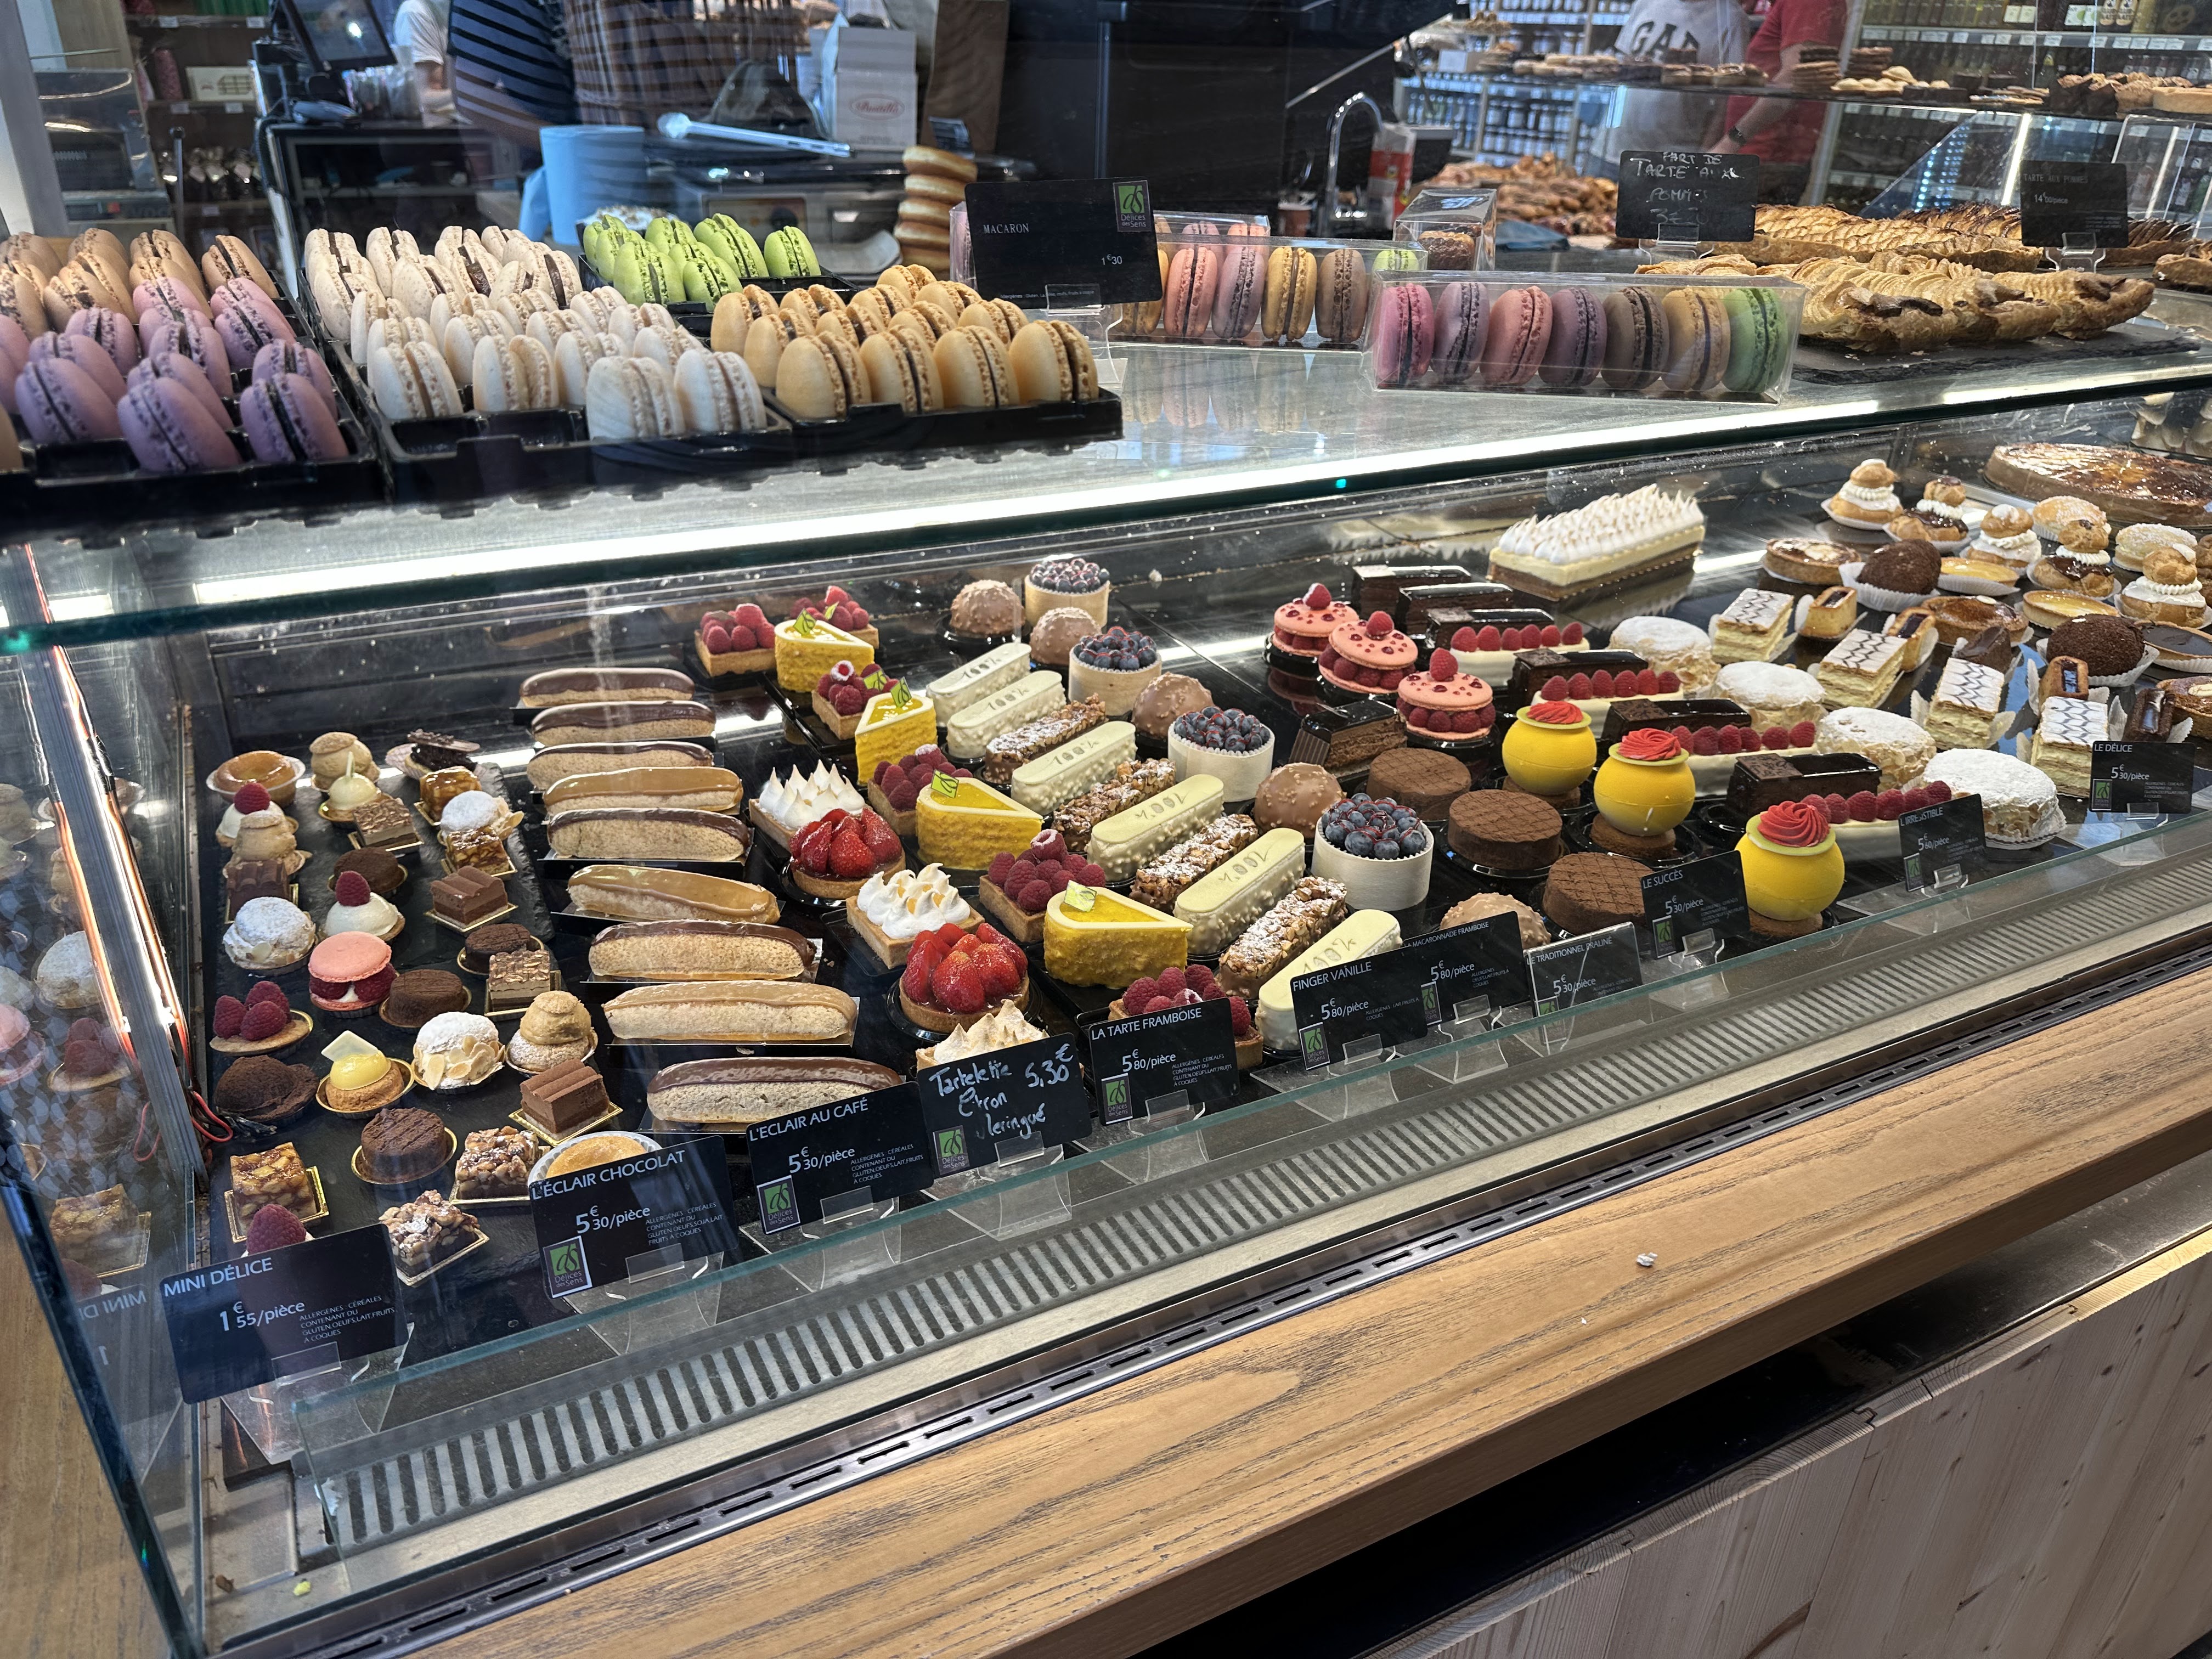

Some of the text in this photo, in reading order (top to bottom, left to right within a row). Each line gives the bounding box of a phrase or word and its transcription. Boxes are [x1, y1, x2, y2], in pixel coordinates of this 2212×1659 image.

[1630, 157, 1686, 178] TARTE
[983, 223, 1029, 234] MACARON
[2094, 742, 2132, 752] LE DÉLICE
[1643, 870, 1683, 889] LE SUCCÈS
[1412, 930, 1457, 947] MACARONNADE
[1458, 922, 1489, 935] FRAMBOISE
[1537, 945, 1585, 963] TRADITIONNEL
[1585, 936, 1612, 950] PRALINÉ
[1293, 961, 1372, 991] FINGER VANILLE
[1092, 1007, 1202, 1040] LA TARTE FRAMBOISE
[749, 1097, 868, 1142] L'ECLAIR AU CAFÉ
[851, 1158, 885, 1171] CONTENANT
[942, 1155, 964, 1165] Délices
[531, 1150, 685, 1200] L'ÉCLAIR CHOCOLAT
[859, 1172, 882, 1183] COQUES
[768, 1209, 792, 1221] Délices
[646, 1217, 685, 1232] CONTENANT
[675, 1227, 701, 1238] COQUES
[164, 1257, 273, 1297] MINI DÉLICE
[555, 1271, 582, 1283] Délices
[301, 1312, 346, 1329] CONTENANT
[311, 1329, 341, 1341] COQUES
